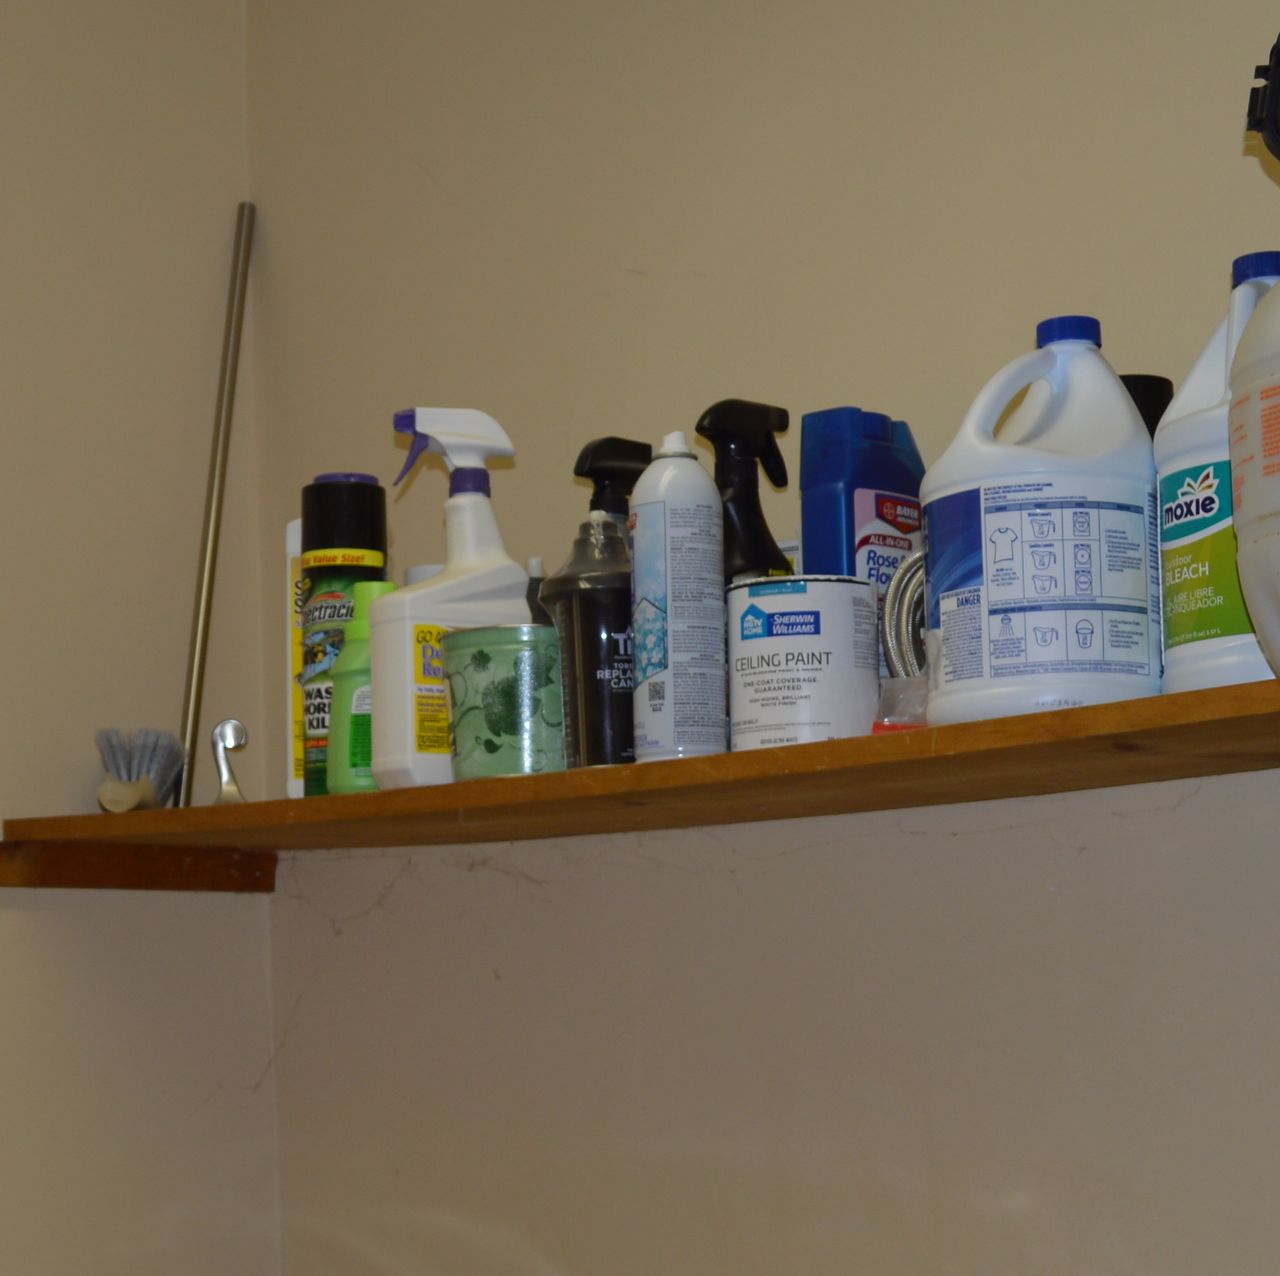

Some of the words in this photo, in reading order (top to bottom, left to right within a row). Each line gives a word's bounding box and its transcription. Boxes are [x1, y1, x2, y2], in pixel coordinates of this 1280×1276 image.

[1164, 495, 1216, 526] moxie
[867, 550, 899, 568] Rose
[1166, 561, 1210, 586] BLEACH
[956, 593, 981, 608] DANGER
[772, 623, 815, 635] WILLIAMS
[735, 652, 782, 672] CEILING
[785, 650, 833, 667] PAINT
